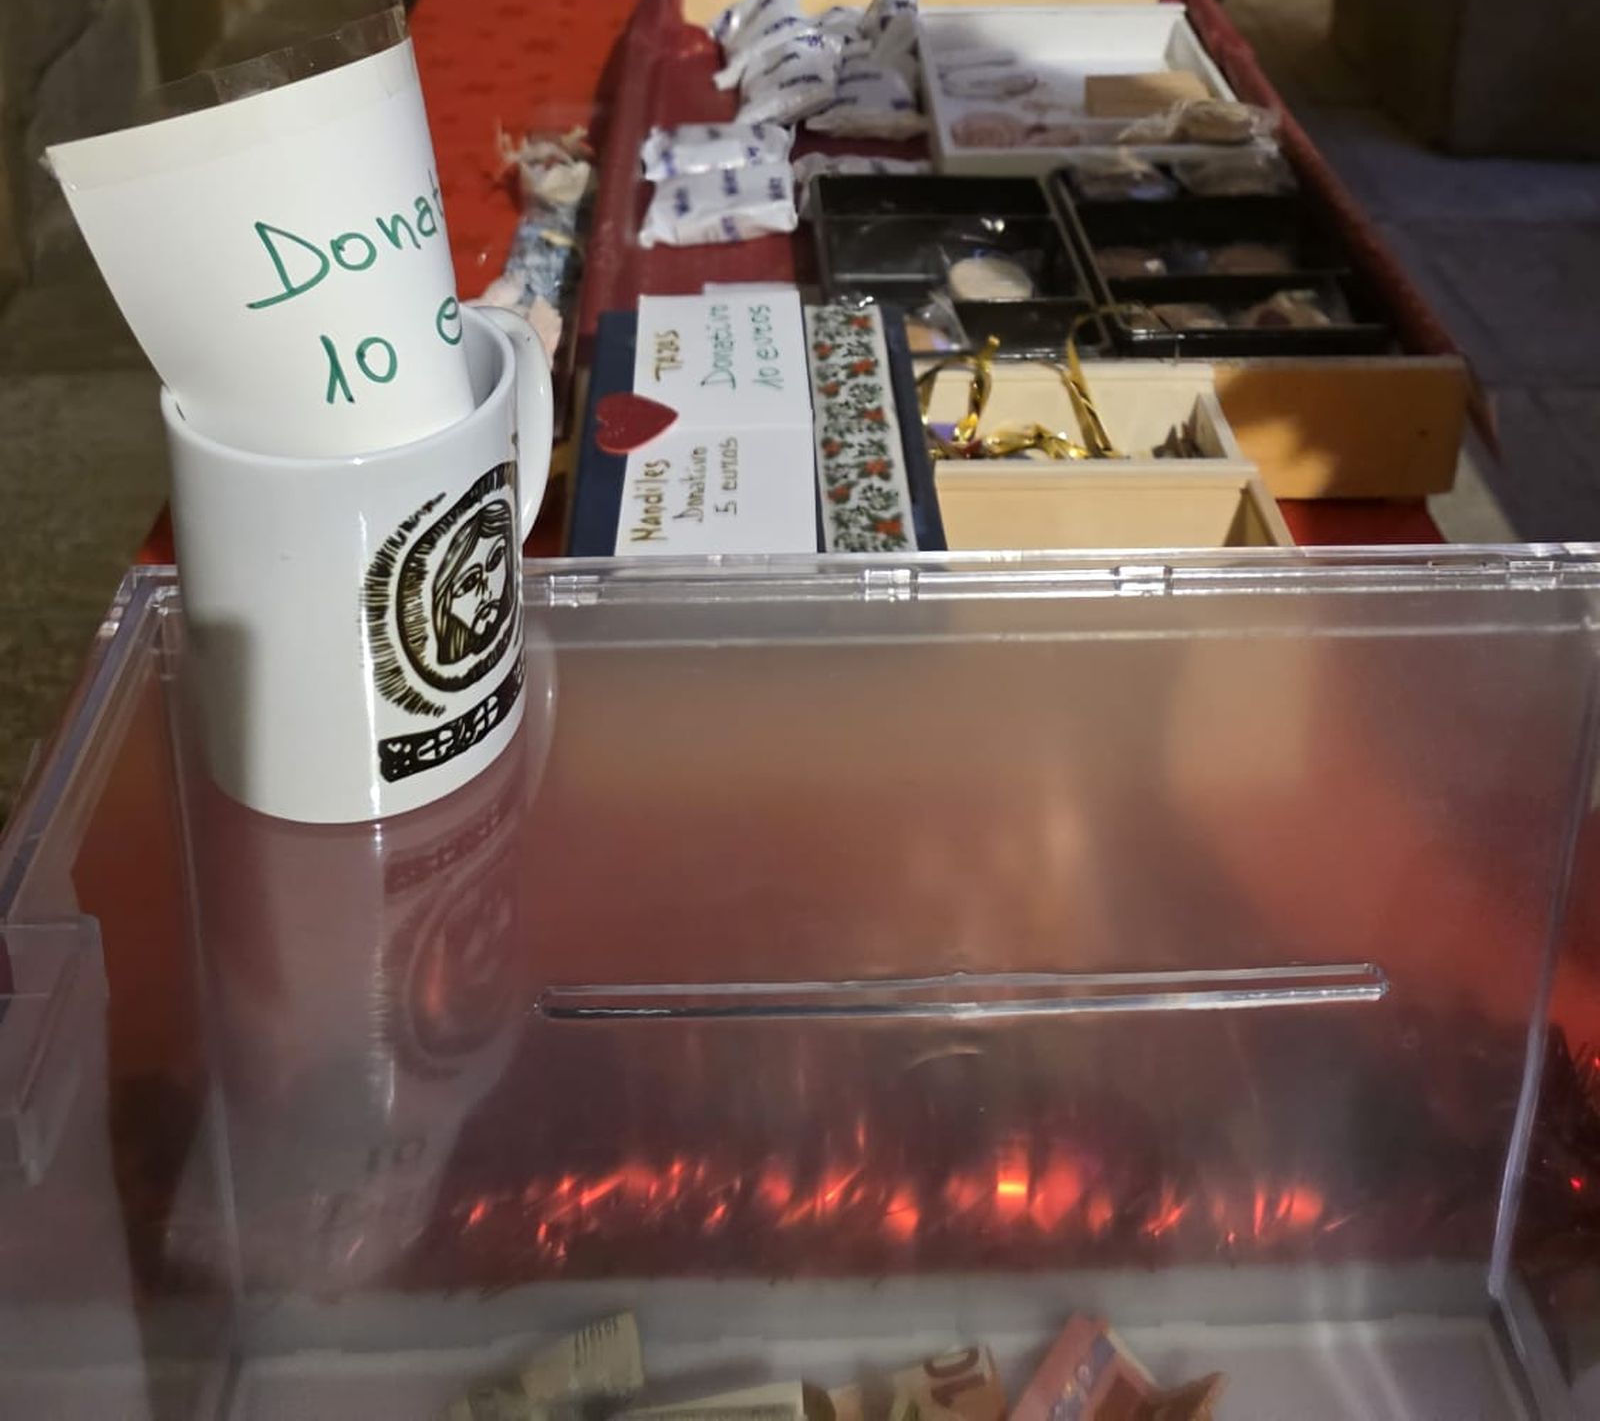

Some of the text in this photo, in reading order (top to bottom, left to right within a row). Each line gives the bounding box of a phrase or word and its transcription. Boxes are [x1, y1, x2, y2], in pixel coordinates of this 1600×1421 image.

[319, 334, 398, 404] 10
[755, 368, 784, 391] 10
[672, 446, 708, 524] Donativo
[713, 436, 739, 516] 5 euros
